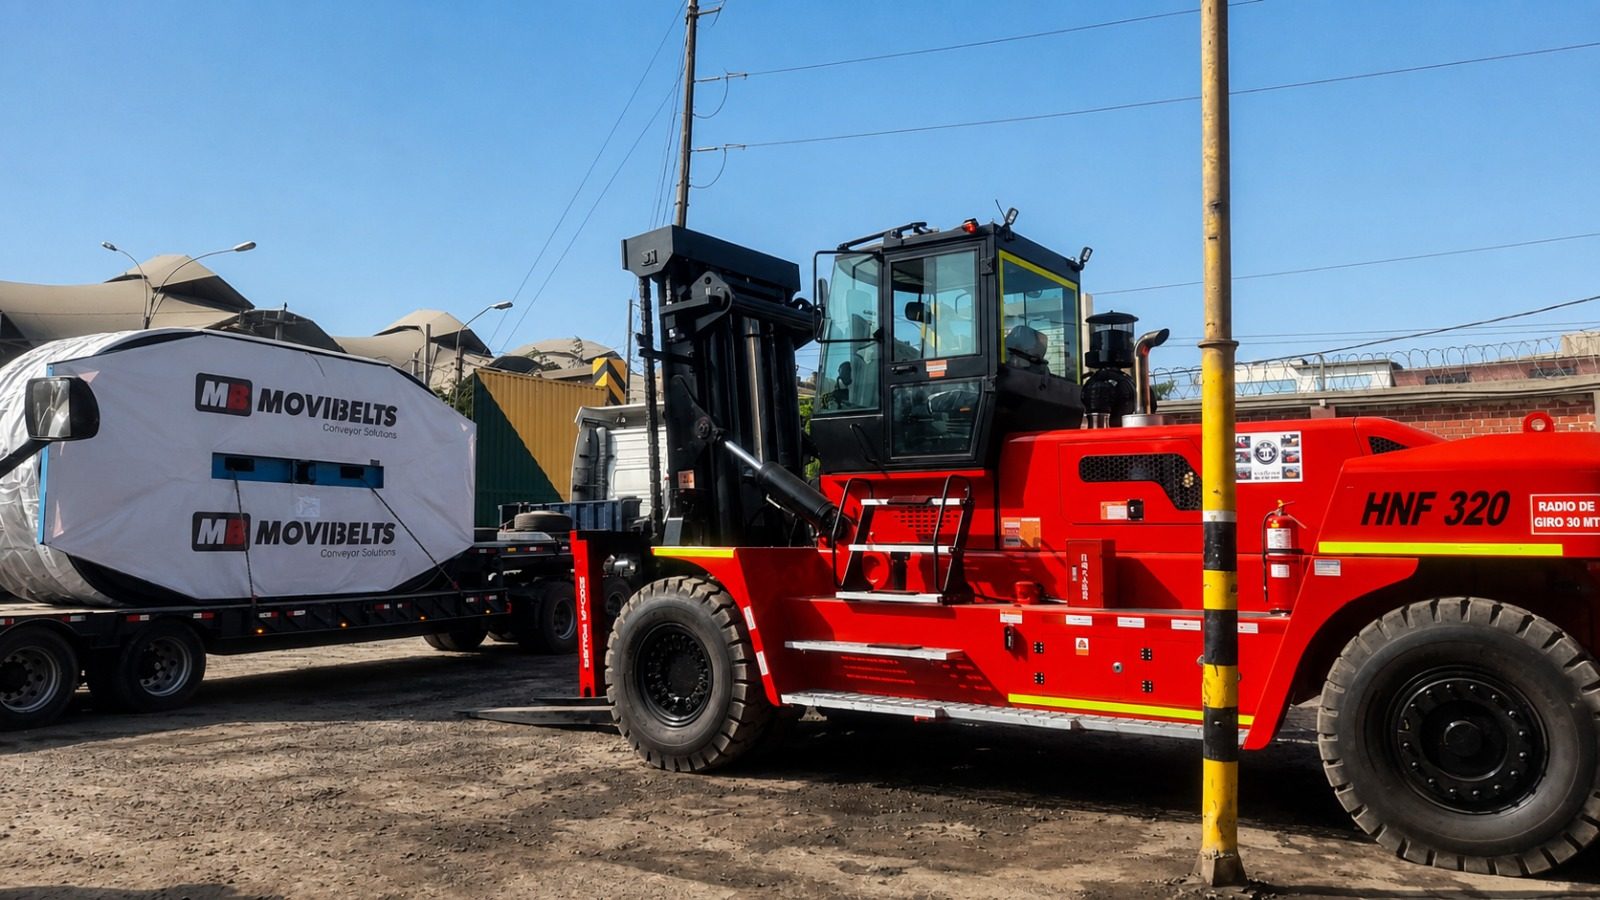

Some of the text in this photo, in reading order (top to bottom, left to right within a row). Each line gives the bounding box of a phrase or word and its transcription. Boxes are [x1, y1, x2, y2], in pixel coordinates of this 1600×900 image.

[200, 379, 398, 427] MB MOVIBELTS
[322, 423, 398, 439] Conveyor Solutions
[1360, 490, 1511, 526] HNF 320
[1538, 501, 1596, 512] RADIO DE
[1534, 517, 1565, 528] GIRO
[1566, 517, 1581, 528] 30
[196, 518, 396, 545] MB MOVIBELTS
[320, 548, 397, 560] Conveyor Solutions
